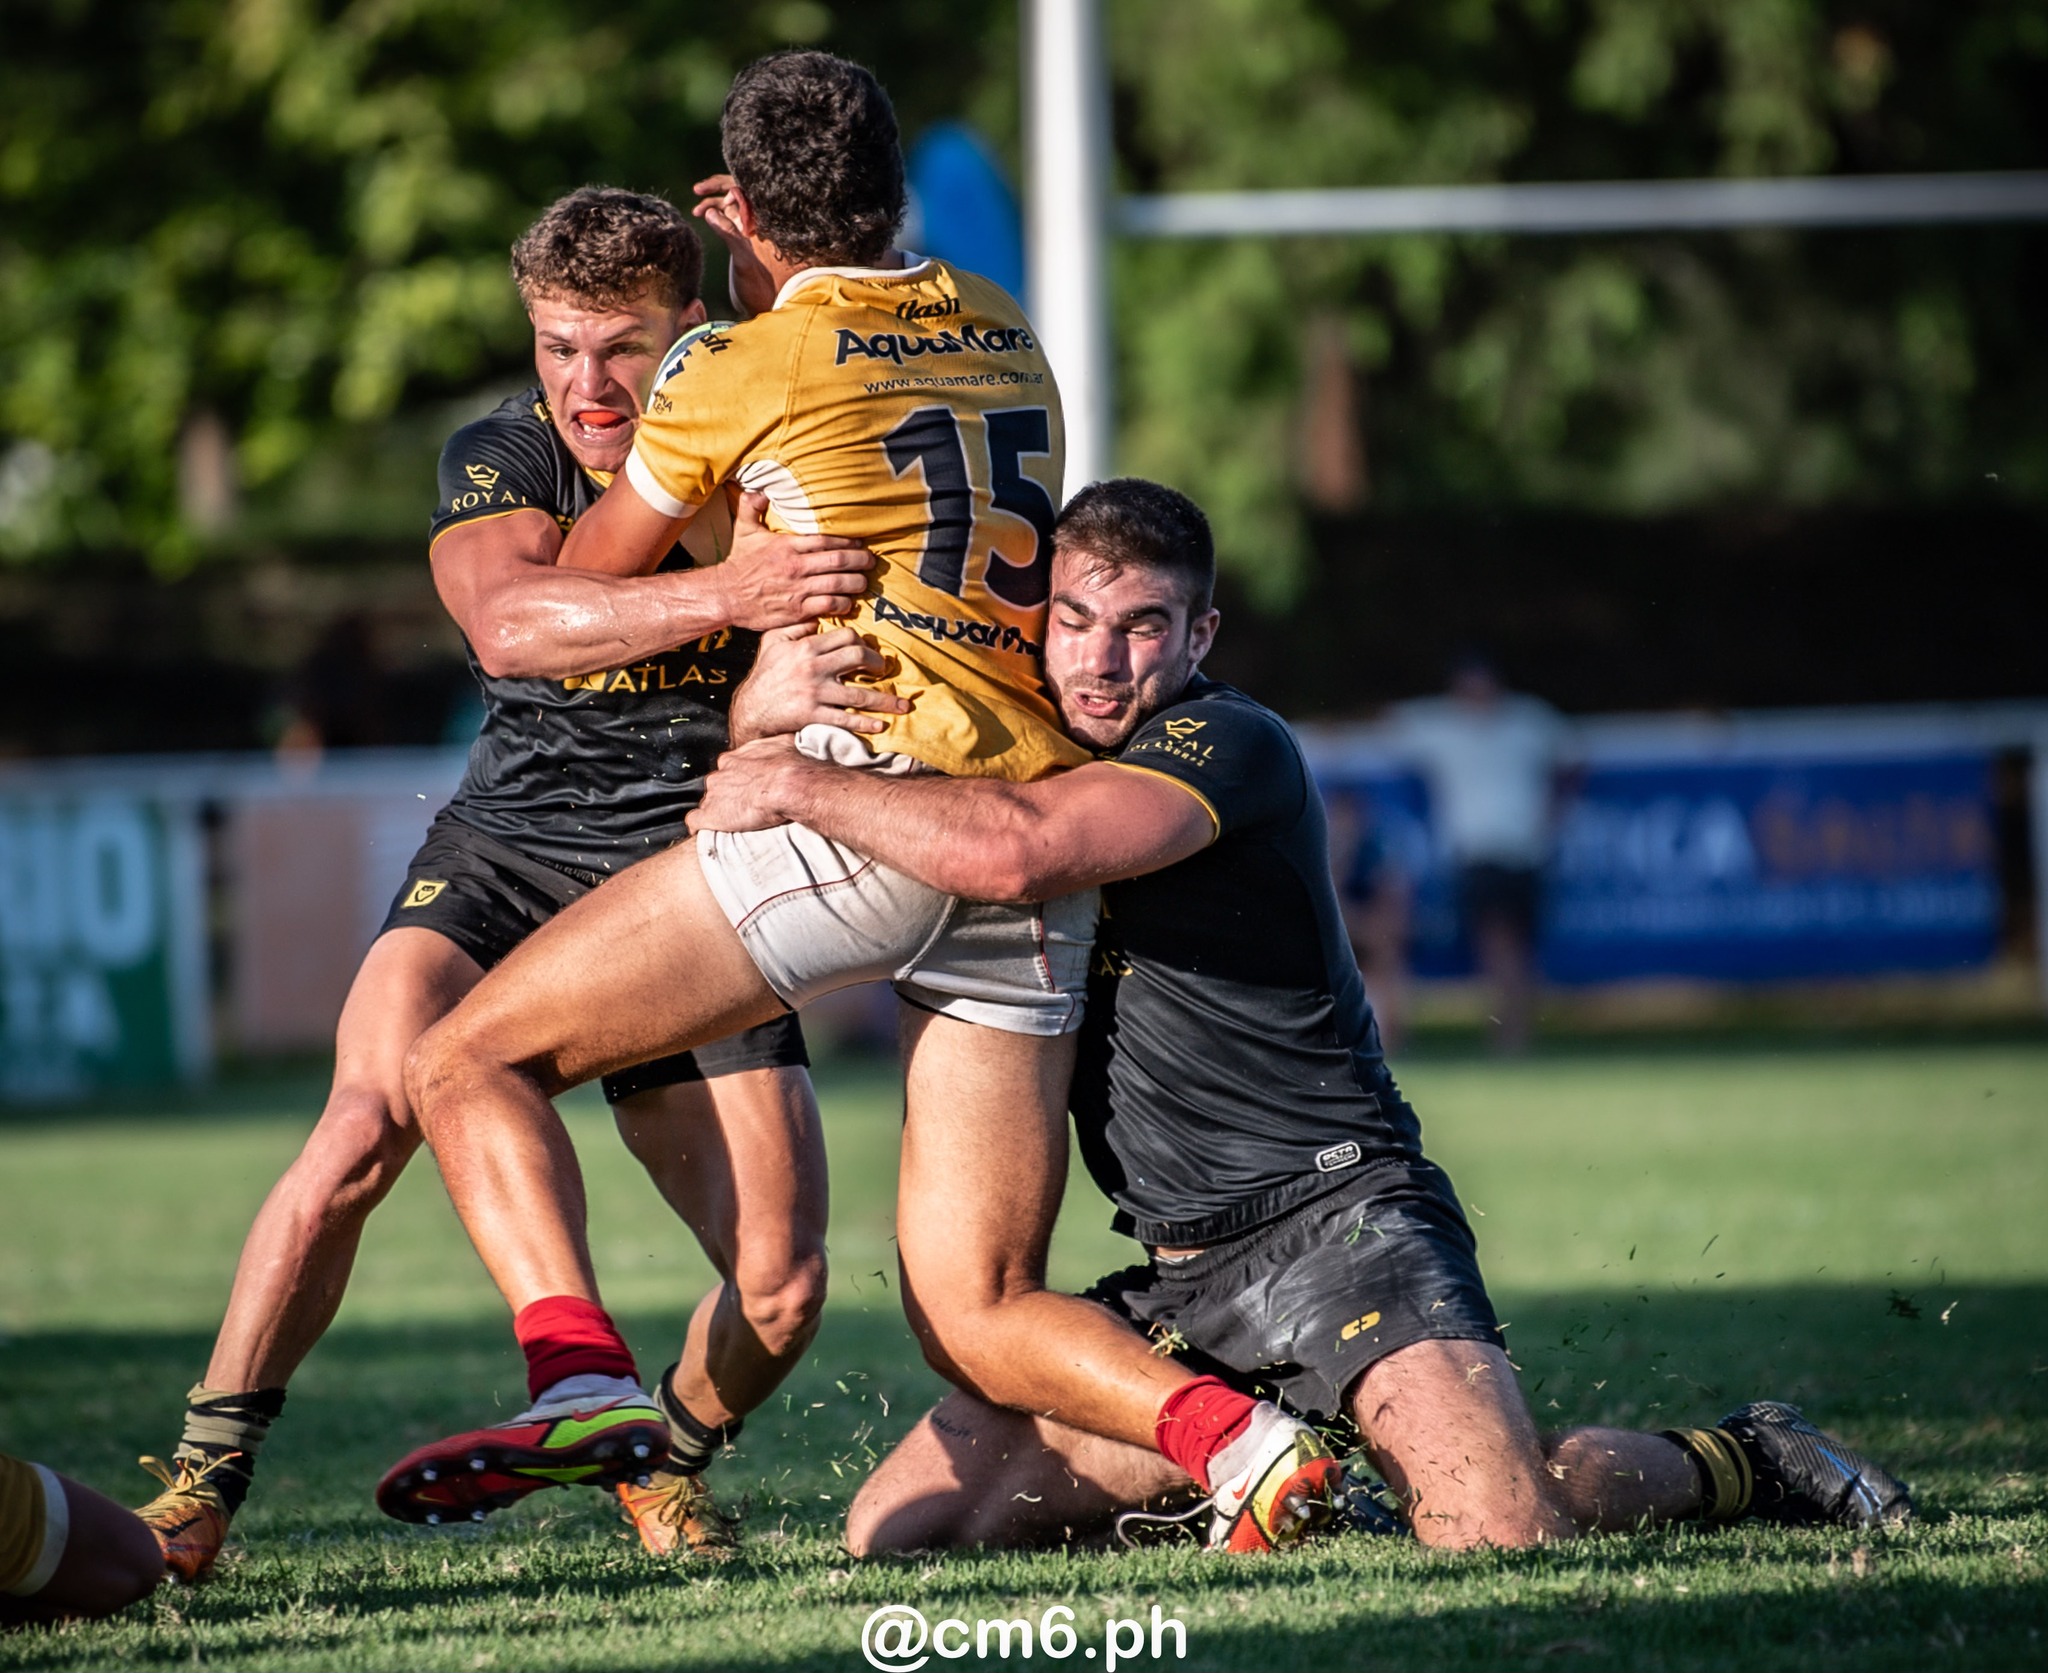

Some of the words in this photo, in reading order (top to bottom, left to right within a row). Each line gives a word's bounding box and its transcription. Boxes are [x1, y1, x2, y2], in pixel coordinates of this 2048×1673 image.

[896, 294, 963, 321] flash
[834, 323, 1035, 366] AquaMare
[882, 404, 1056, 612] 15
[607, 664, 728, 693] ATLAS
